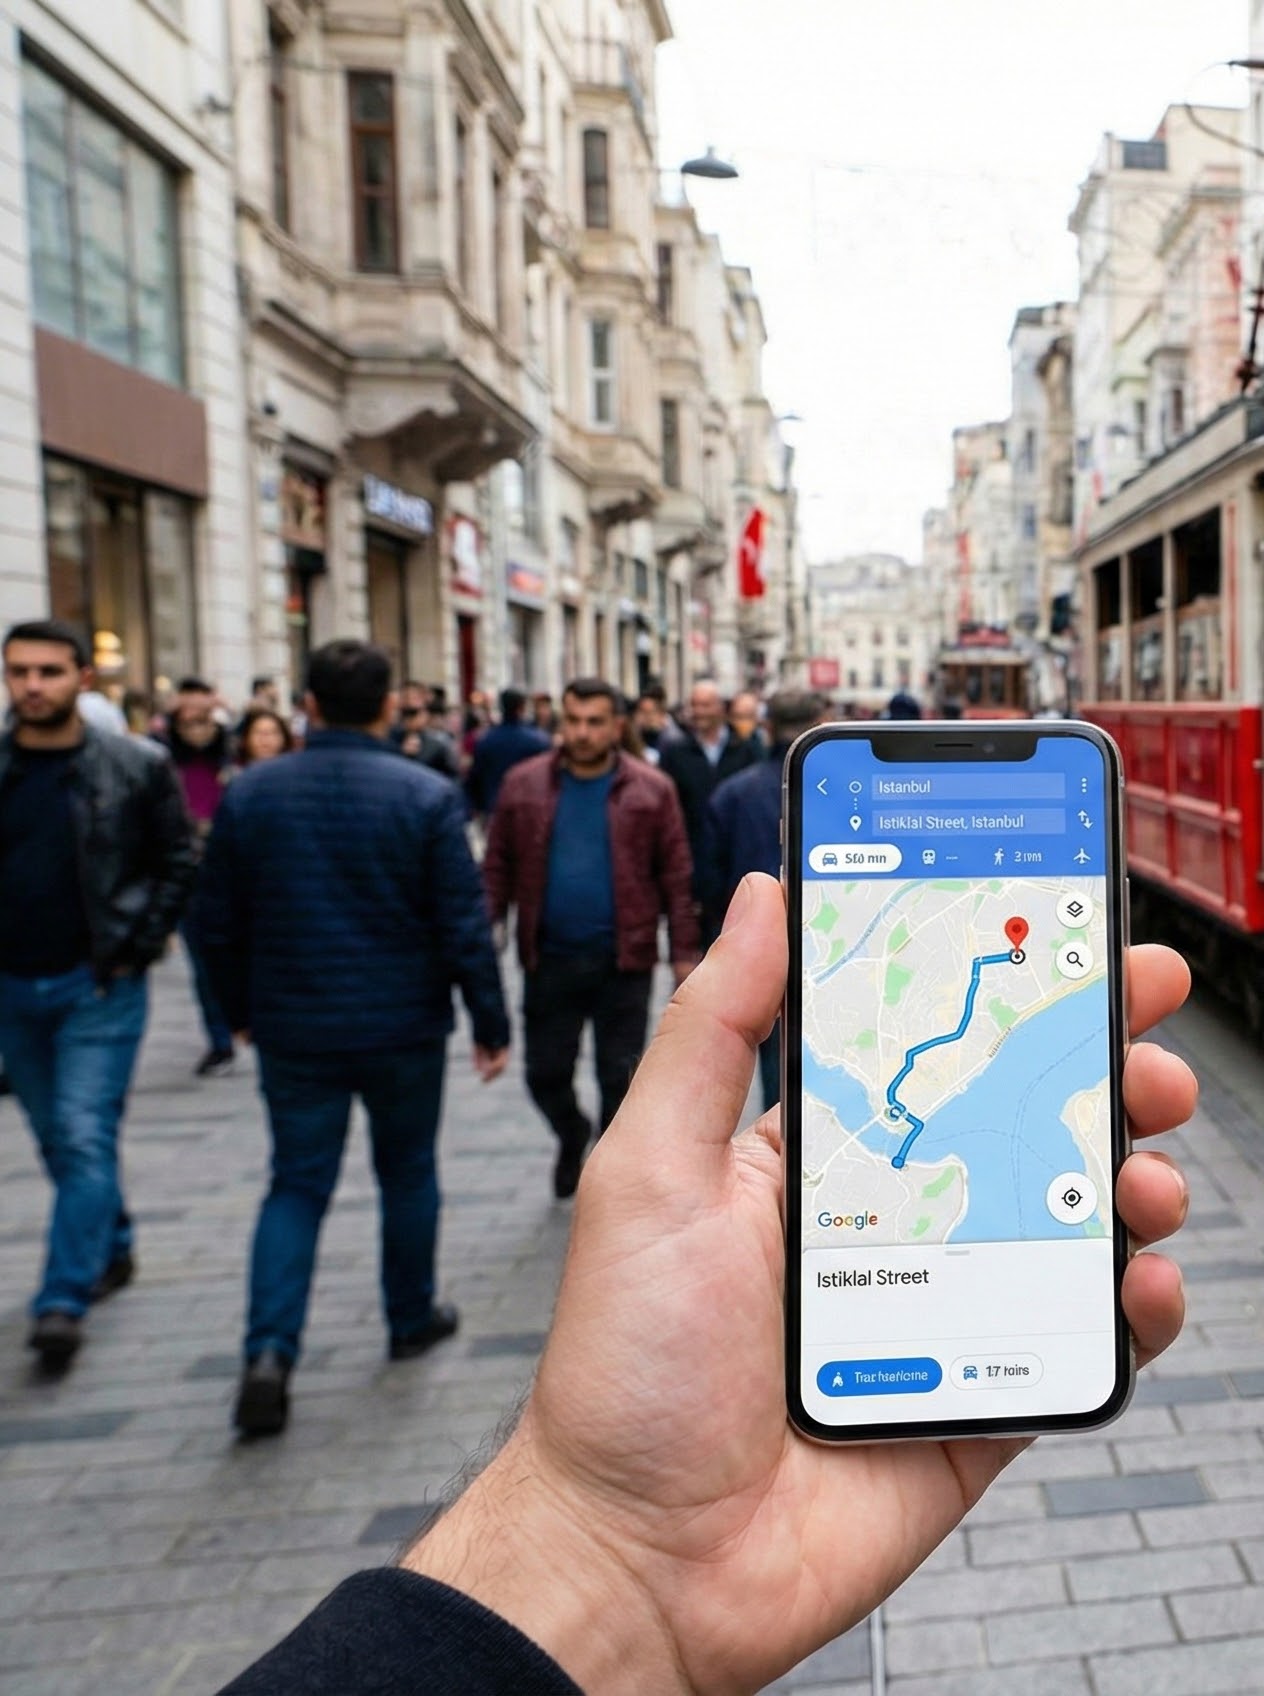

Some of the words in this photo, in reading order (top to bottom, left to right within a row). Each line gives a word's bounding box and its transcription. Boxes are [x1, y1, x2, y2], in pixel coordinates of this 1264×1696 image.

[879, 780, 931, 793] Istanbul
[972, 814, 1024, 828] Istanbul
[818, 1211, 878, 1230] Google
[818, 1269, 871, 1287] Istiklal
[877, 1269, 929, 1285] Street
